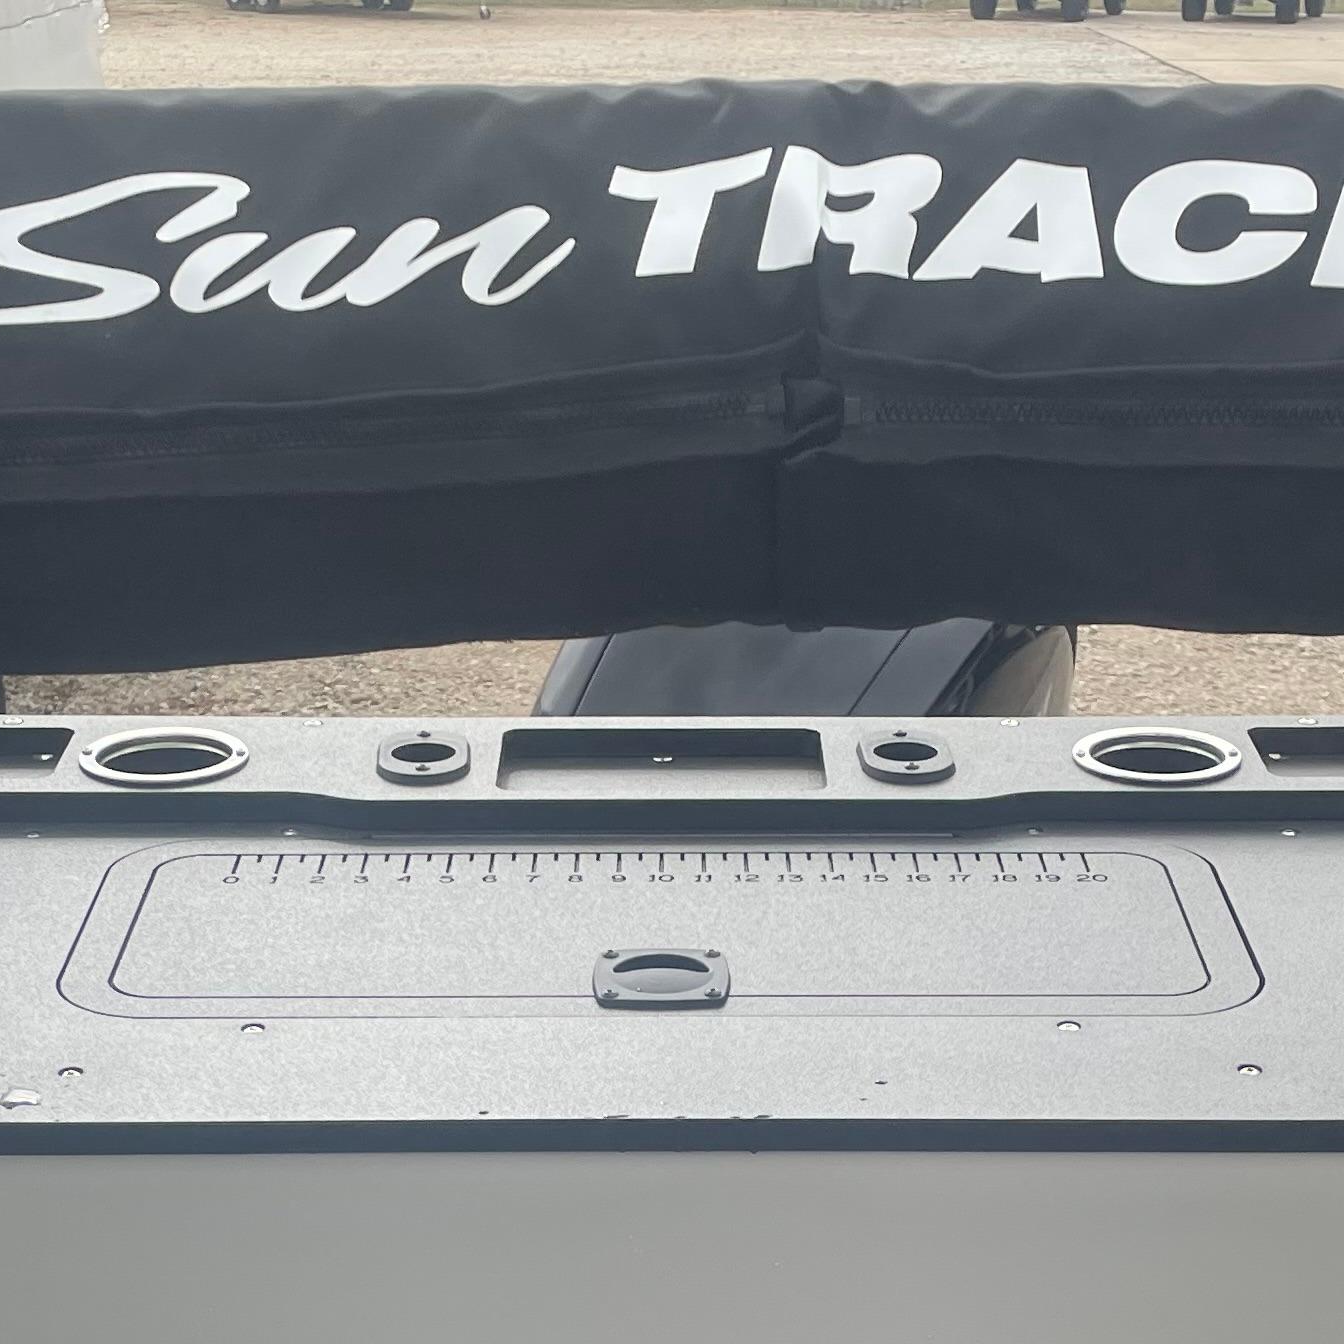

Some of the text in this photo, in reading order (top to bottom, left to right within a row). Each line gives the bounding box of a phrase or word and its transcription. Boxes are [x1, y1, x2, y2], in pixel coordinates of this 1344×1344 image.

[222, 874, 1109, 884] 0 1 2 3 4 5 6 7 8 9 10 11 12 13 14 15 16 17 18 19 20
